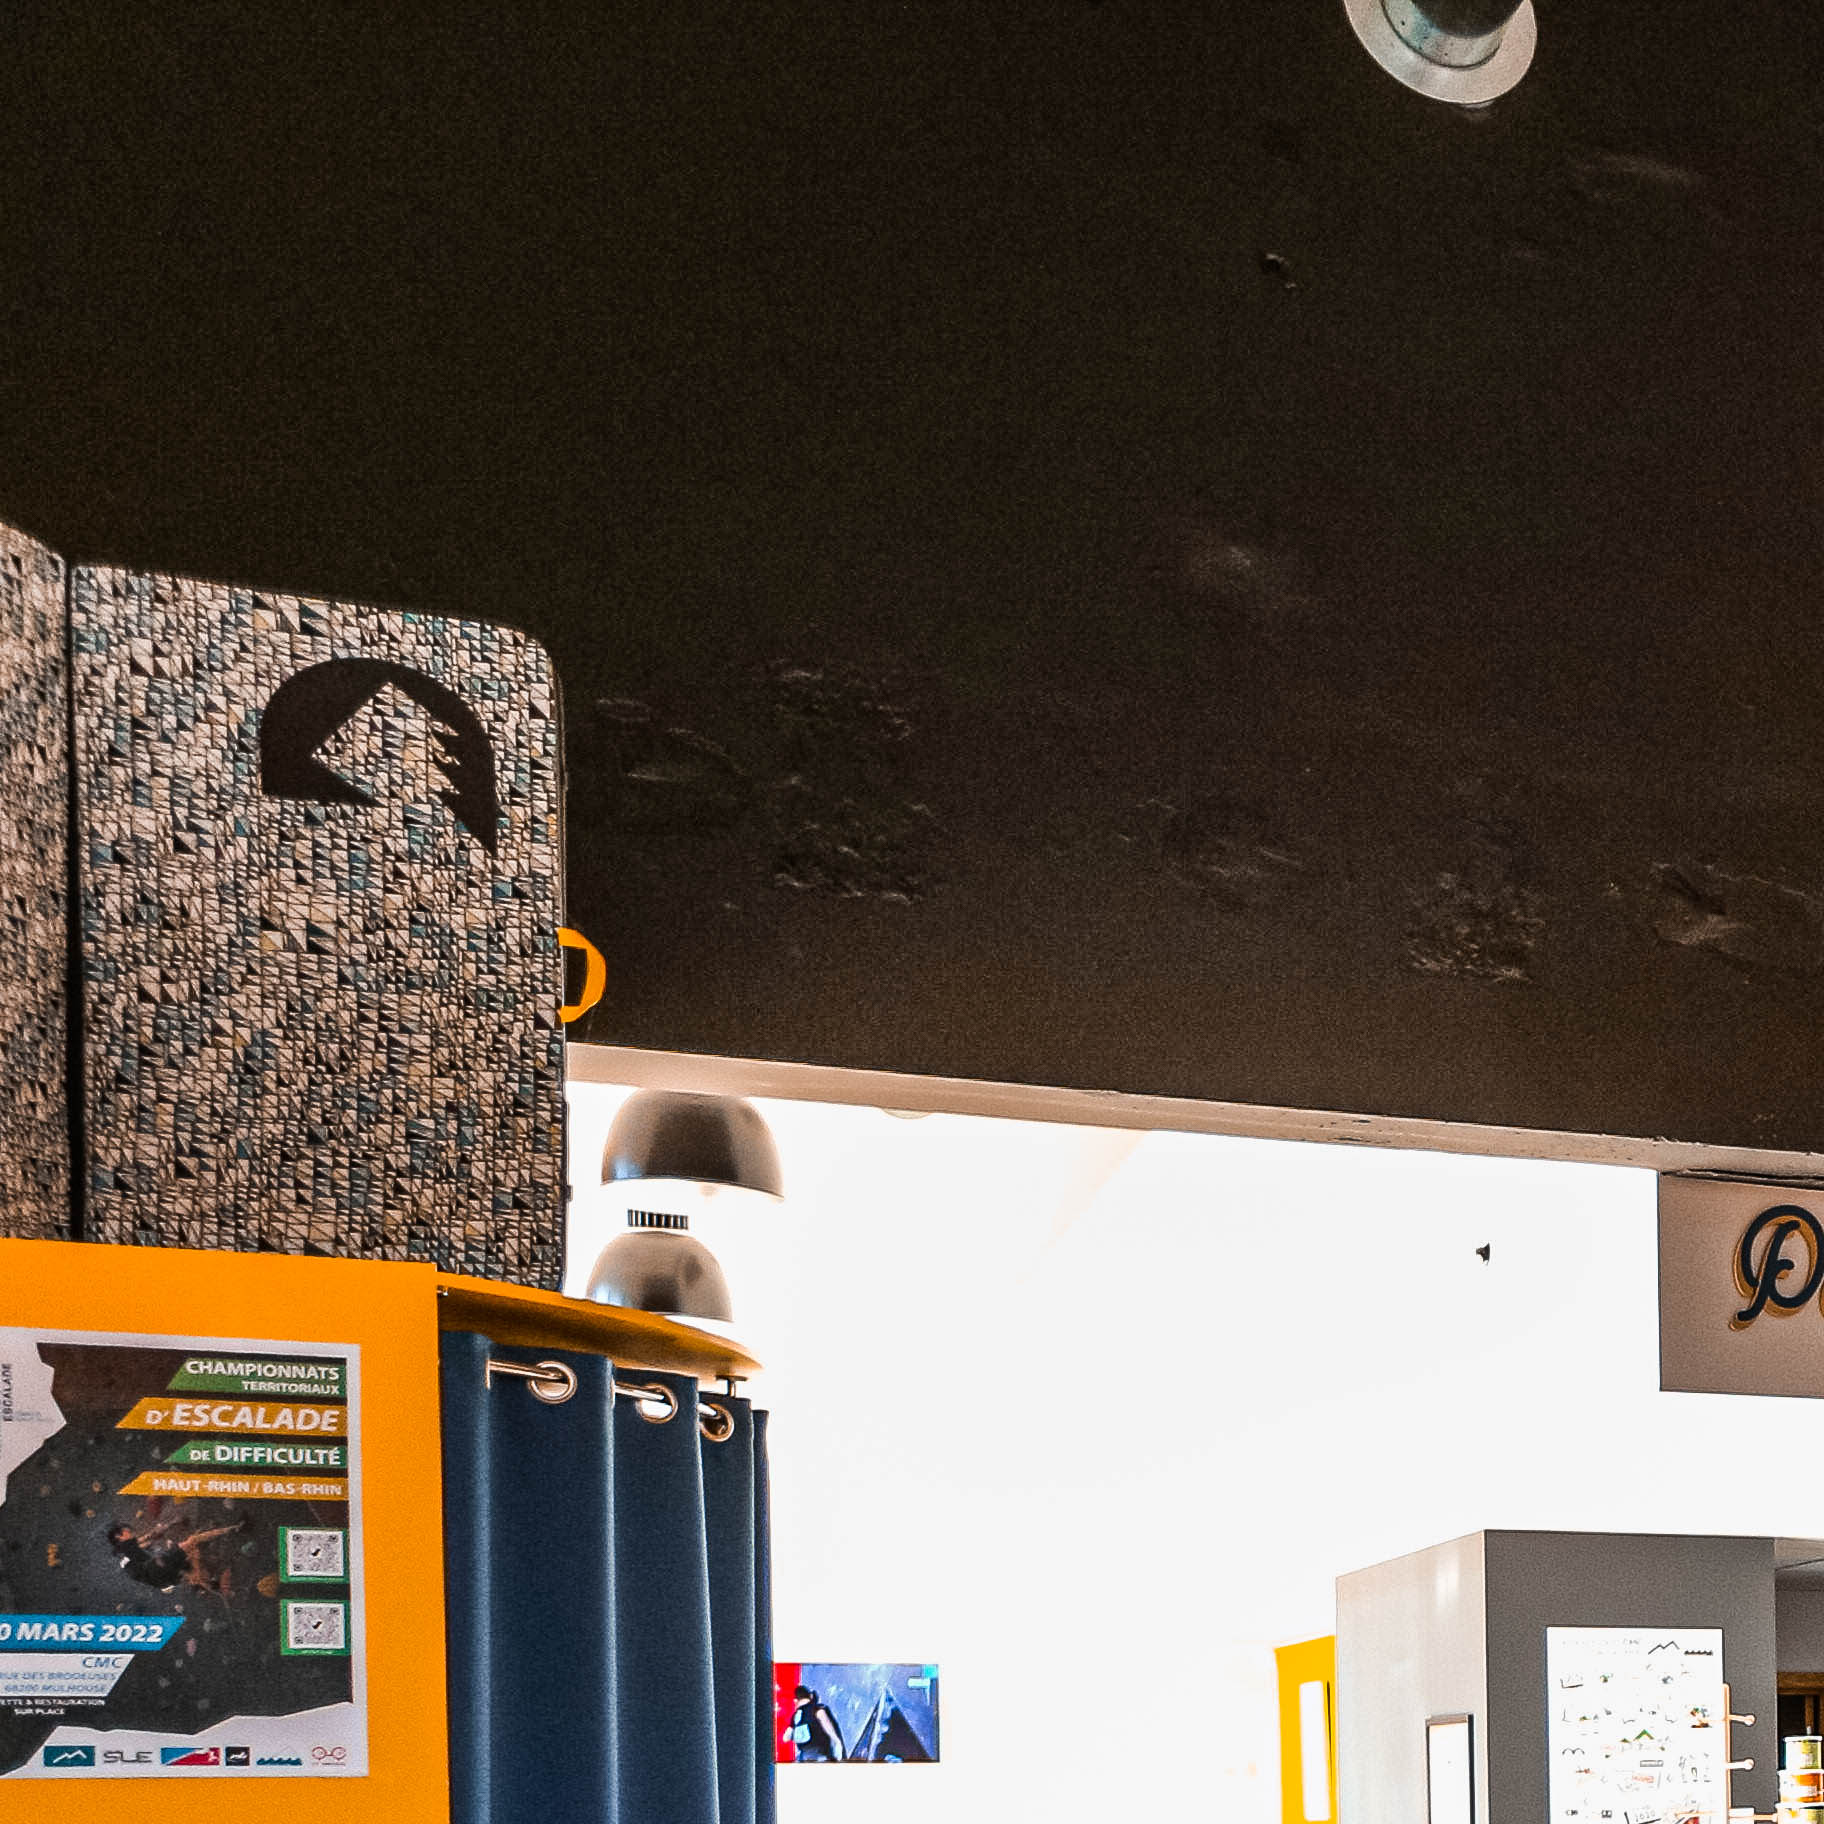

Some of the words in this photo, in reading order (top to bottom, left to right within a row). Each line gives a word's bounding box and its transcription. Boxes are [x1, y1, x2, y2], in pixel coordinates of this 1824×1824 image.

[185, 1360, 340, 1381] CHAMPIONNATS
[242, 1380, 340, 1395] TERRITORIAUX
[172, 1403, 340, 1431] ESCALADE
[189, 1449, 210, 1462] DE
[215, 1444, 341, 1465] DIFFICULTÉ
[152, 1478, 250, 1493] HAUT-RHIN
[263, 1480, 342, 1496] BAS-RHIN
[17, 1623, 96, 1642] MARS
[99, 1624, 163, 1643] 2022
[82, 1656, 123, 1668] CMC
